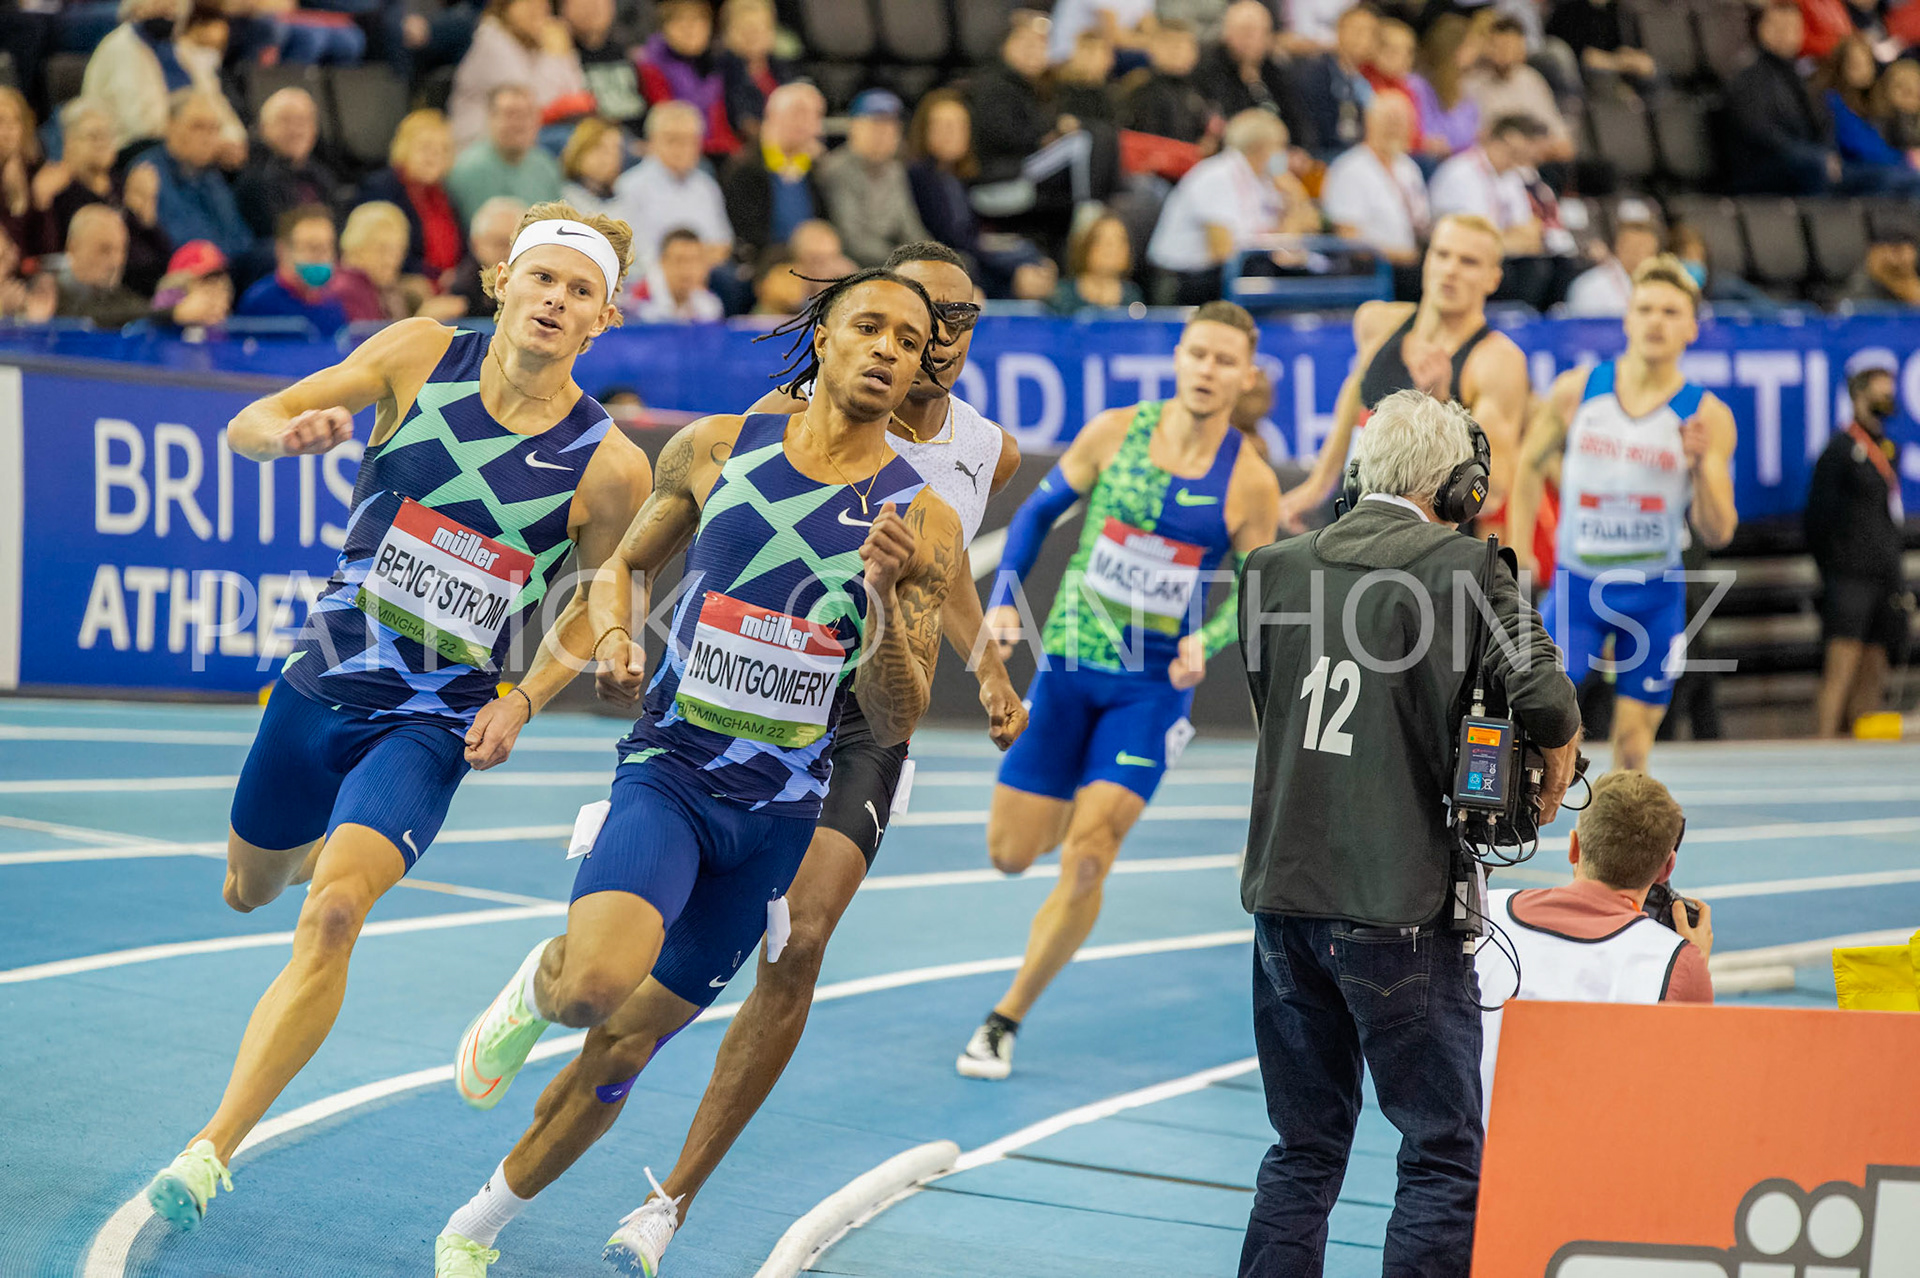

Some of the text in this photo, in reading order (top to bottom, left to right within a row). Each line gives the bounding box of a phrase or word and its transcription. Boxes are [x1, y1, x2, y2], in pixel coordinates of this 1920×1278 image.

[431, 526, 500, 571] müller
[78, 564, 331, 658] ATHLE
[375, 543, 509, 631] BENGTSTROM
[357, 596, 457, 654] BIRMINGHAM 22
[739, 614, 813, 651] müller
[689, 641, 835, 707] MONTGOMERY
[678, 701, 764, 734] BIRMINGHAM
[766, 726, 785, 739] 22
[1300, 655, 1361, 756] 12
